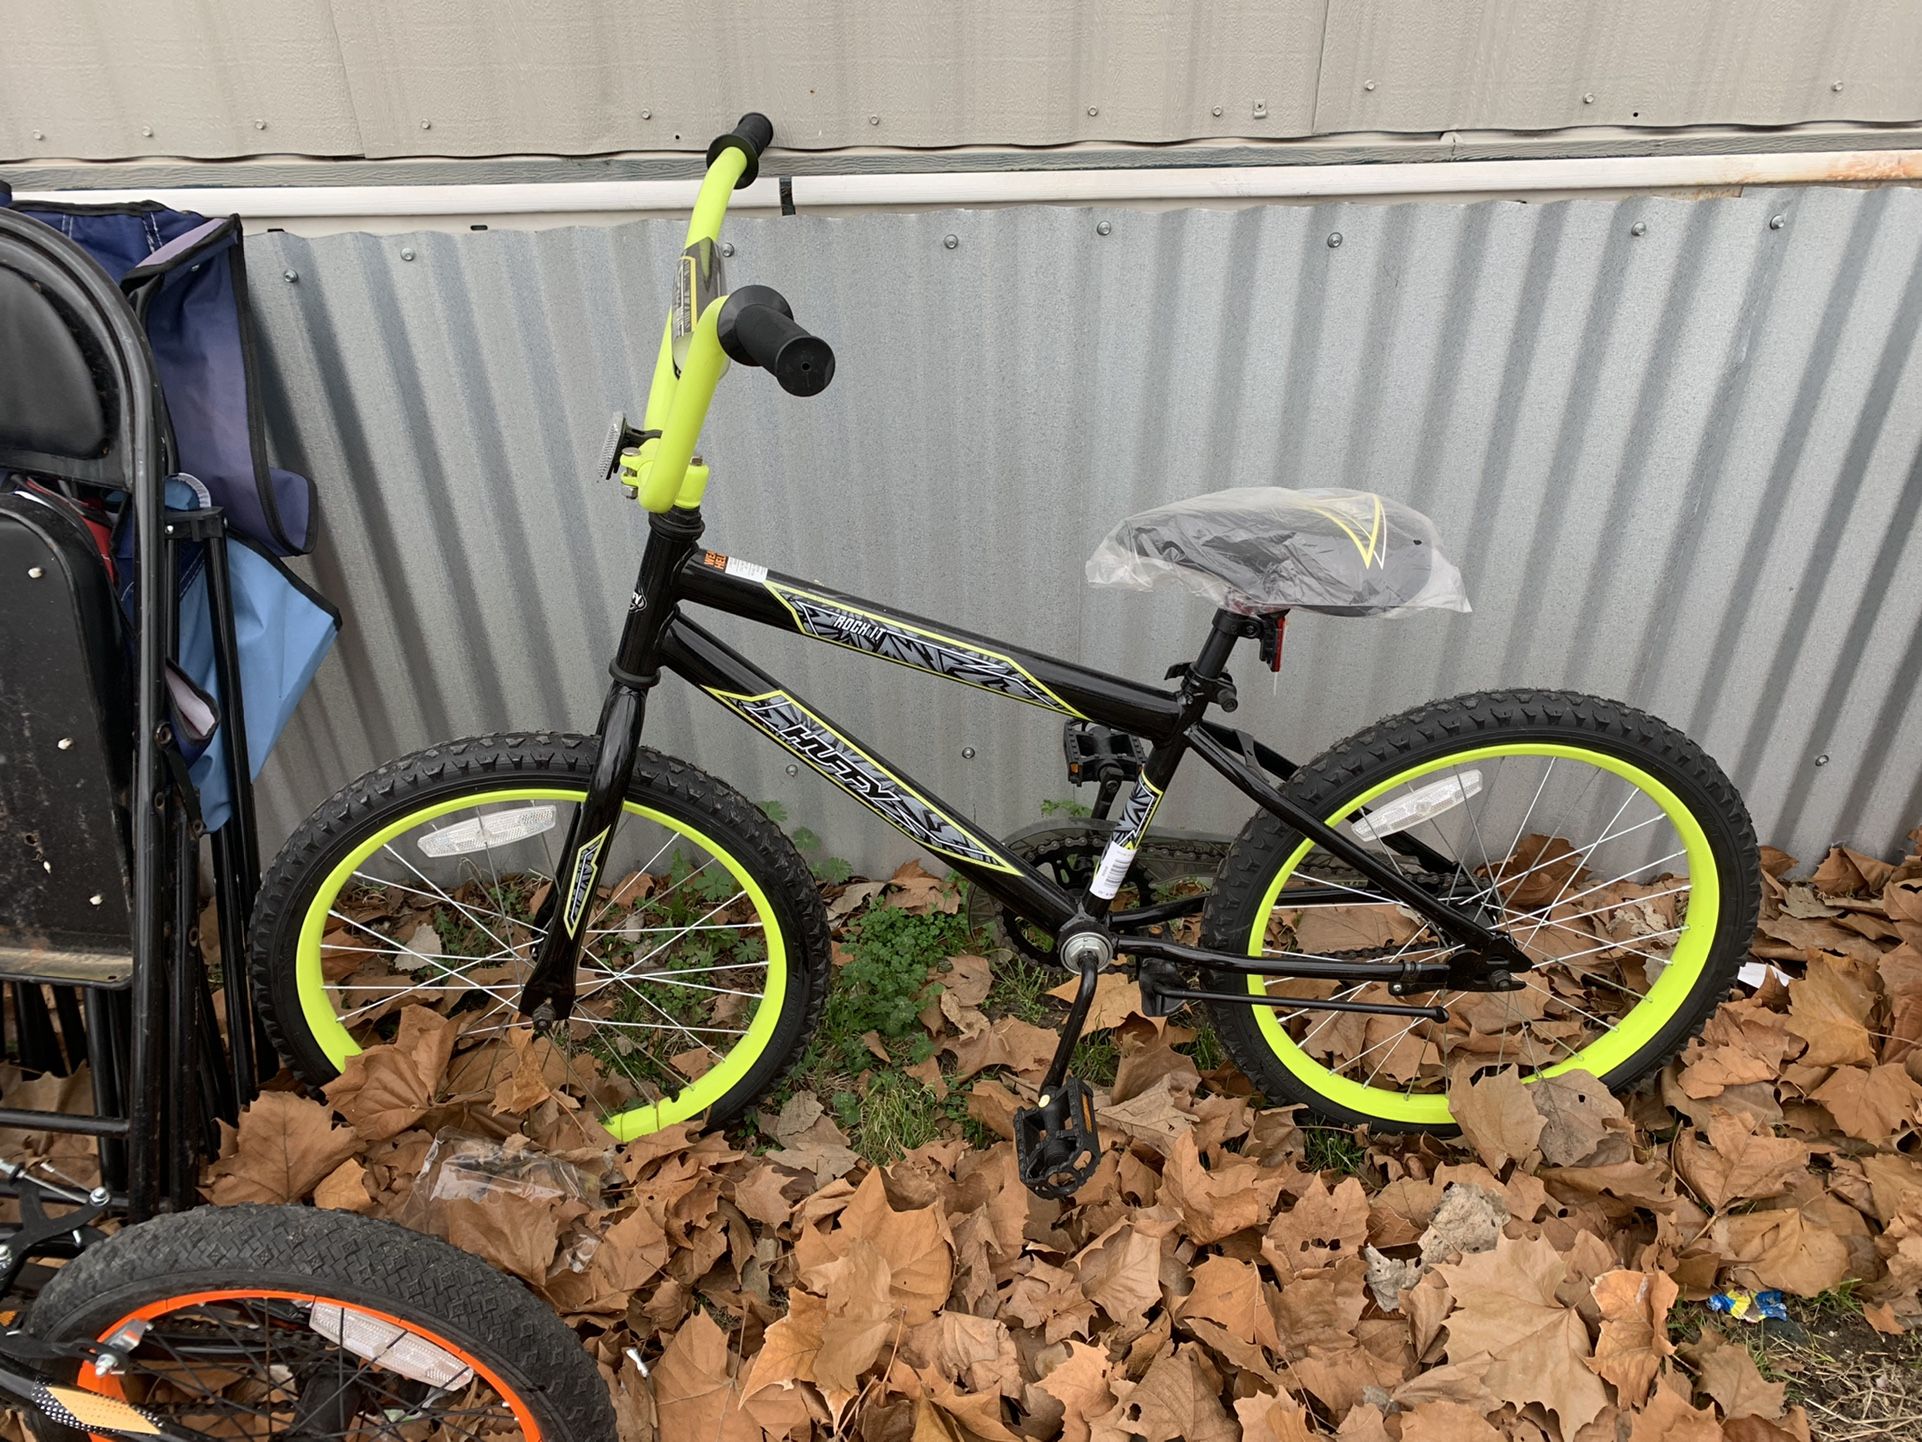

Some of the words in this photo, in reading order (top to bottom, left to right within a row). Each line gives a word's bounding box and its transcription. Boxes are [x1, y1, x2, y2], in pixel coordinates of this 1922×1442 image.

[833, 615, 871, 636] ROCK
[869, 626, 887, 640] IT
[780, 724, 901, 802] HUFFY
